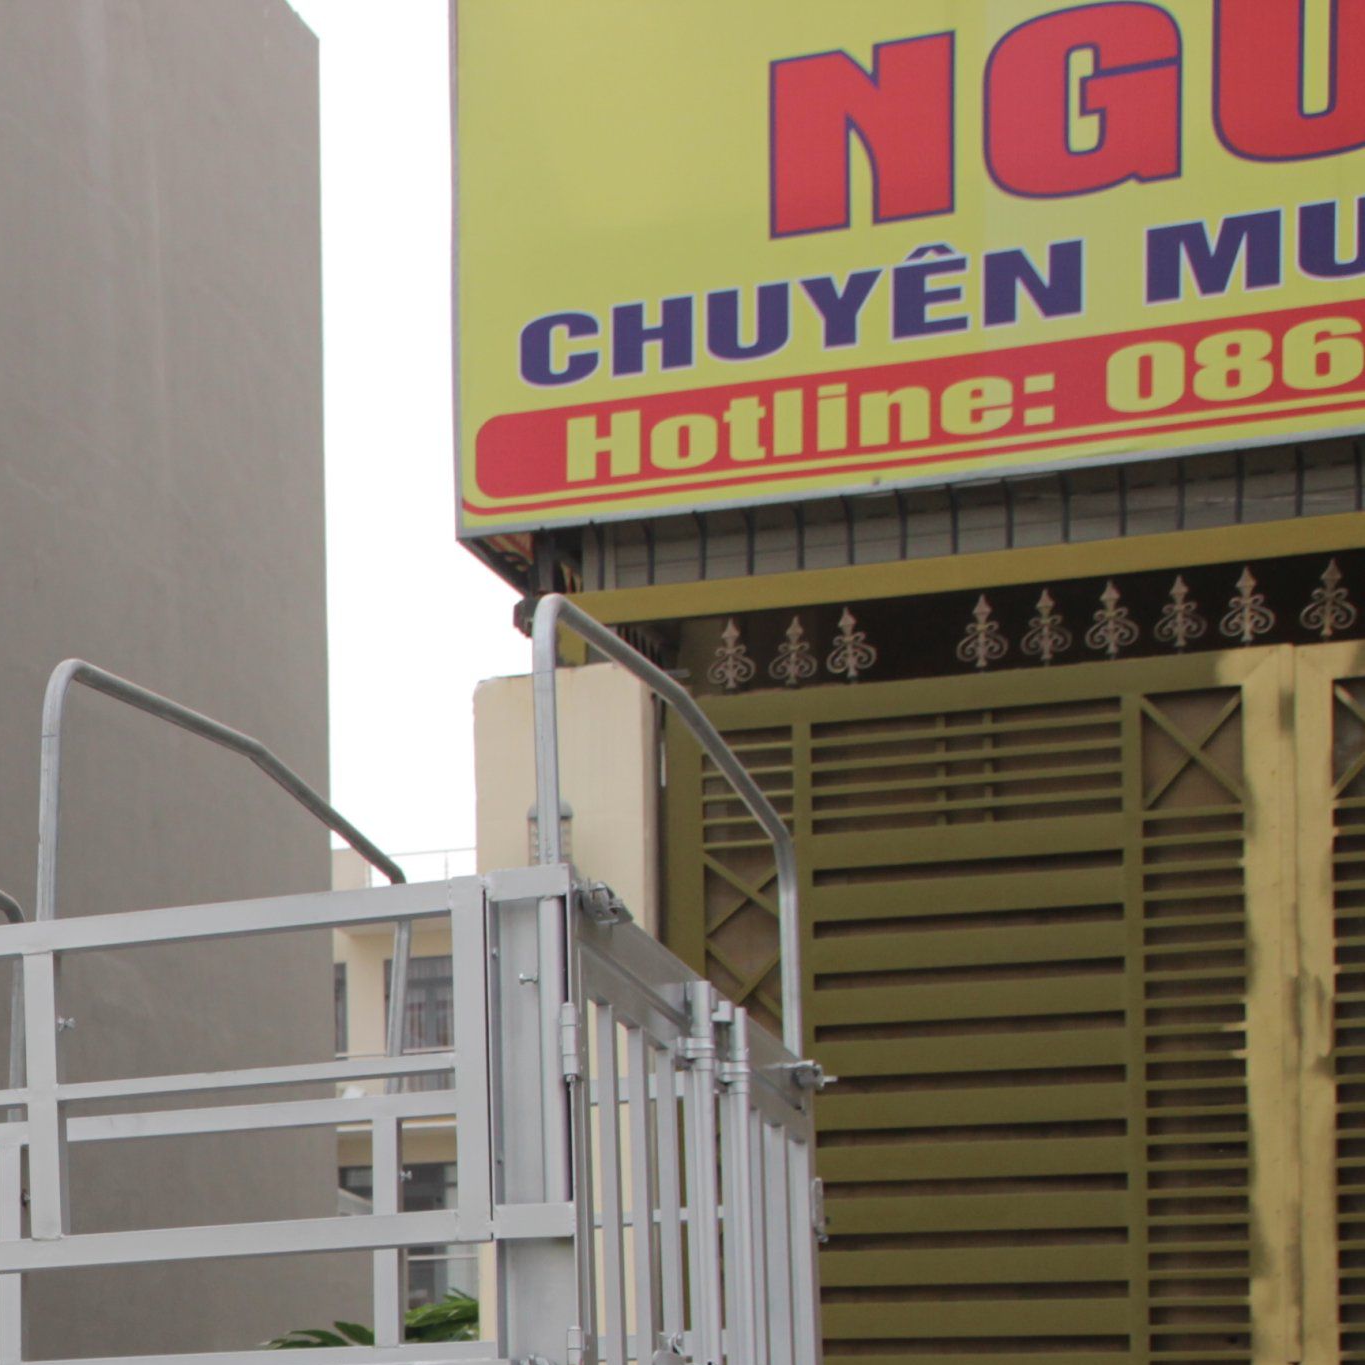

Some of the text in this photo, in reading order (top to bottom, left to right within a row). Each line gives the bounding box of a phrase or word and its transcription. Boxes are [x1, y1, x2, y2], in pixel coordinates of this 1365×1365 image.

[519, 196, 1365, 387] CHUYÊN MU
[566, 317, 1365, 482] Hotline: 086
